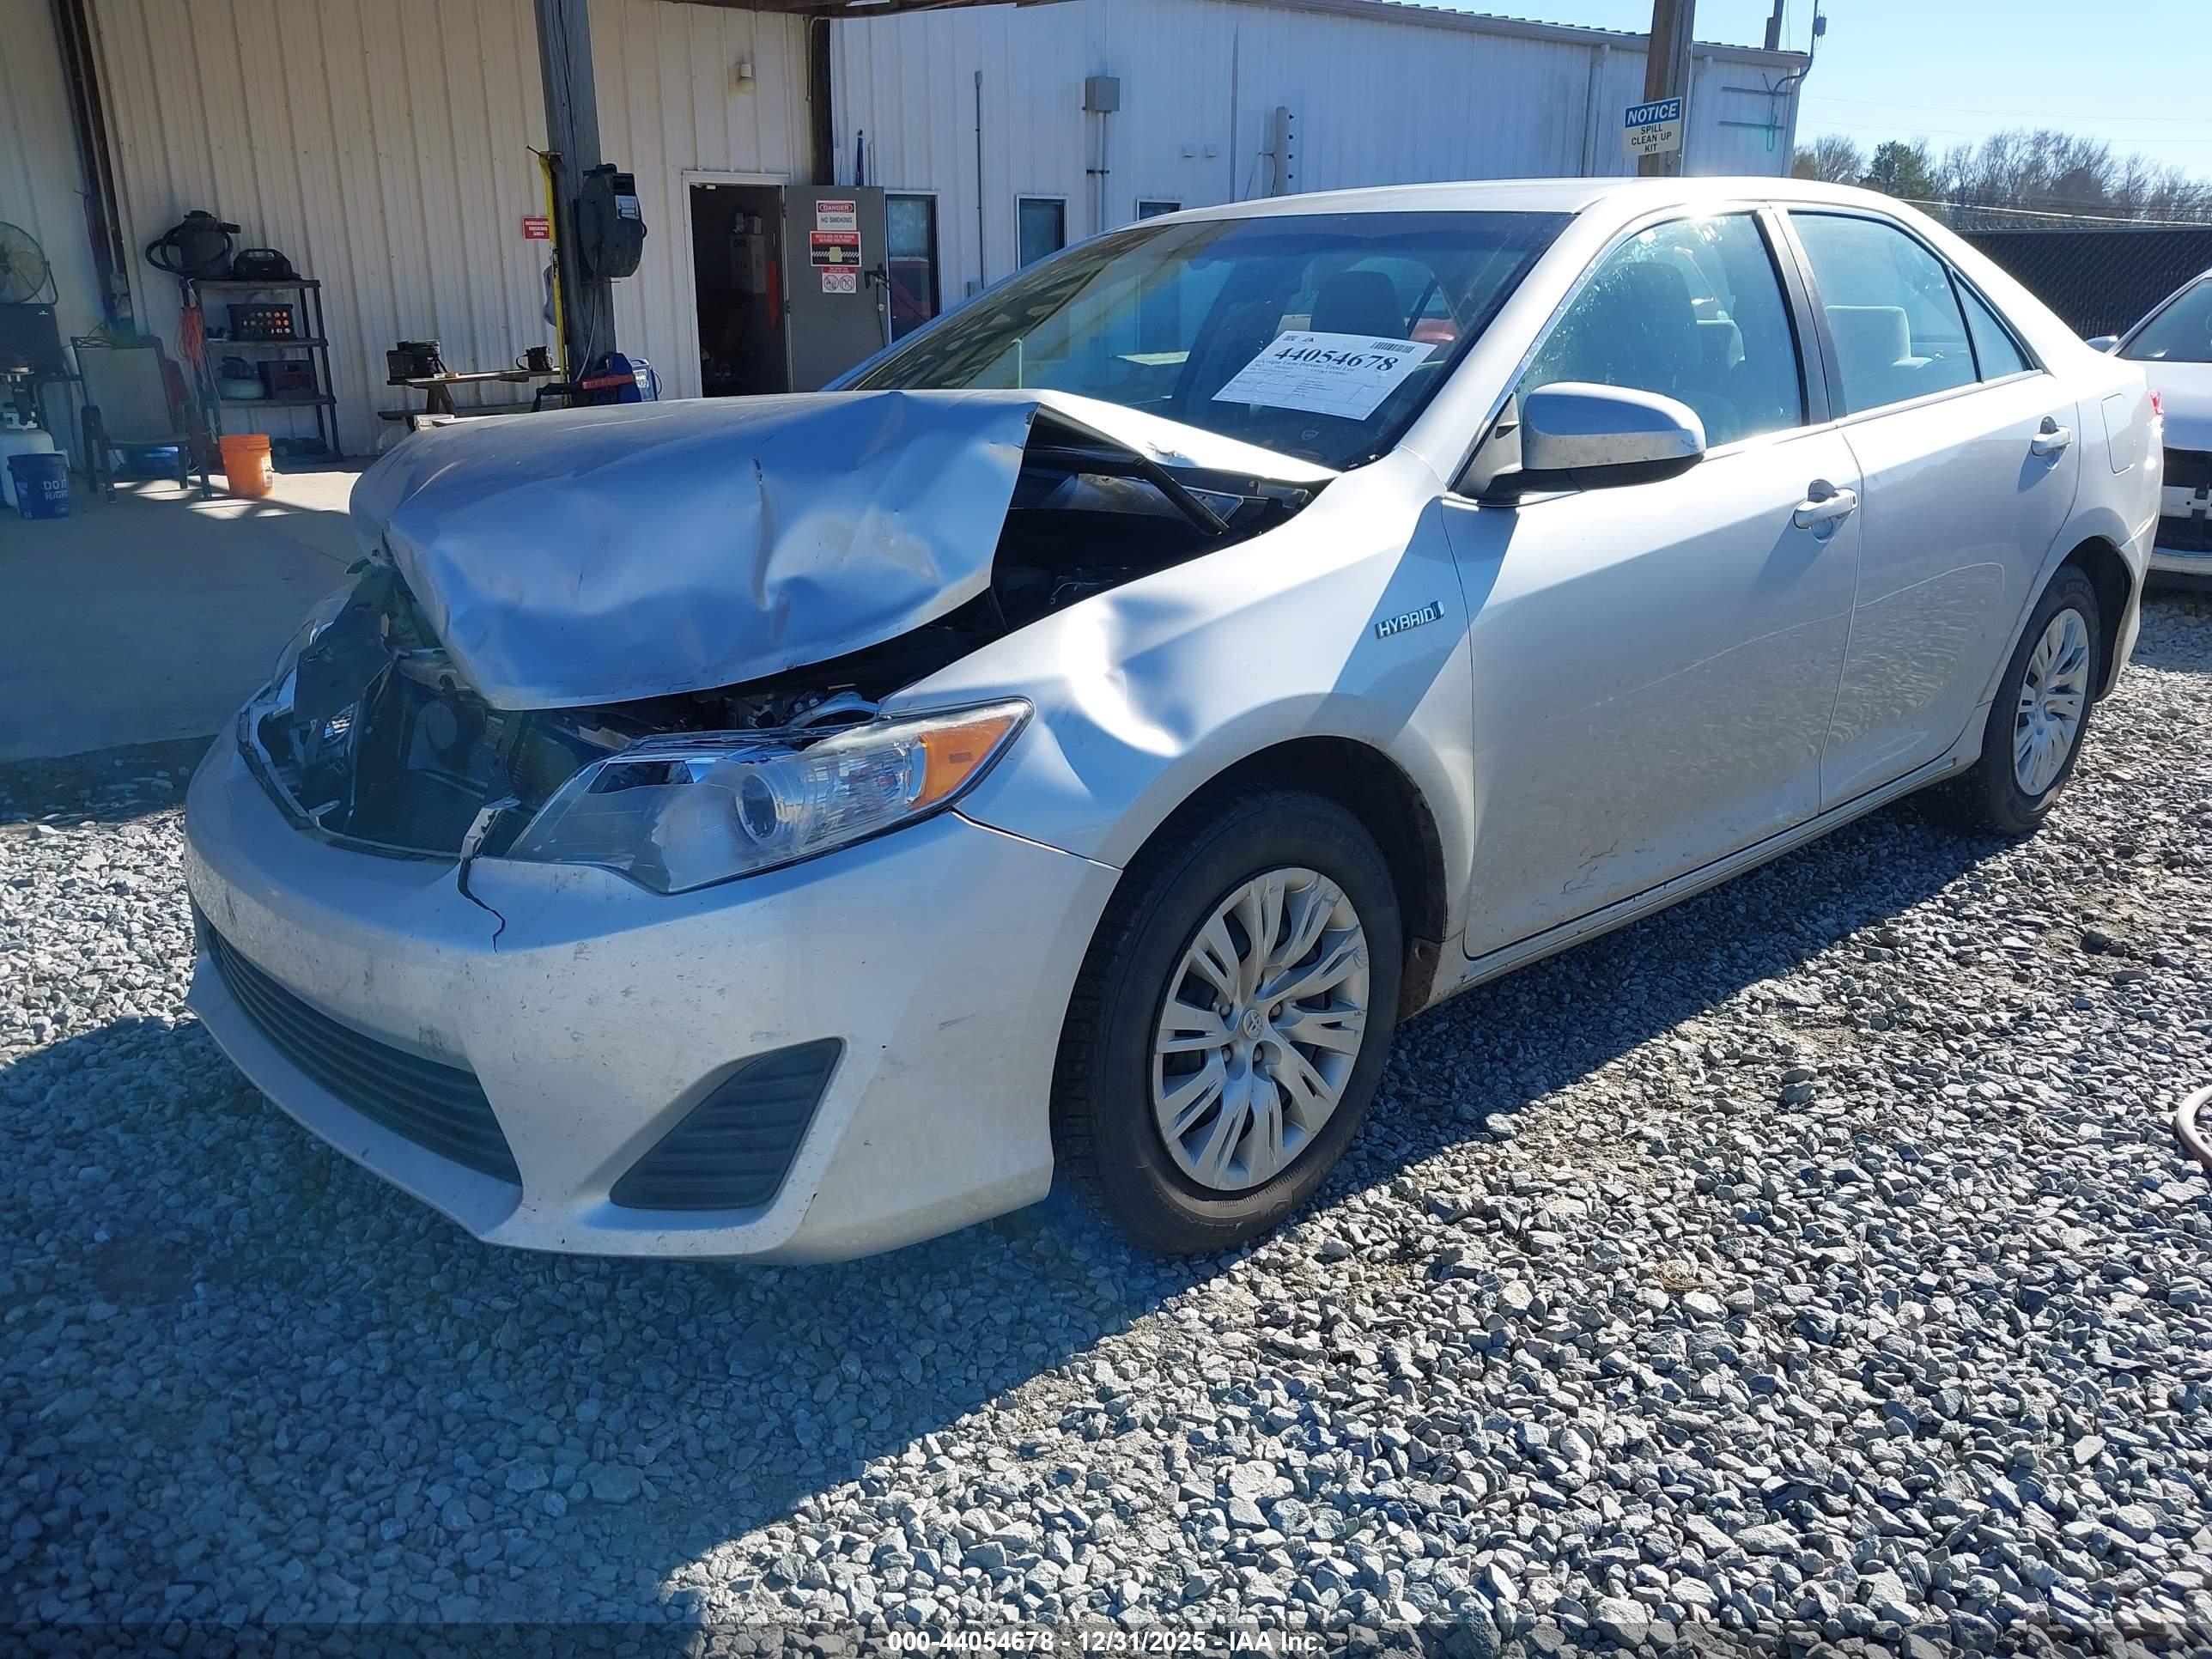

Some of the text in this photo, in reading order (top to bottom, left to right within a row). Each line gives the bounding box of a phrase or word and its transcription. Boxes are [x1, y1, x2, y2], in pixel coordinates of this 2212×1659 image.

[1627, 102, 1679, 125] NOTICE
[1640, 123, 1663, 135] SPILL
[1631, 131, 1673, 146] CLEAN UP
[1644, 143, 1658, 154] KIT
[1274, 346, 1399, 372] 44054678
[43, 480, 60, 490] DO
[1376, 605, 1437, 638] HYBRID
